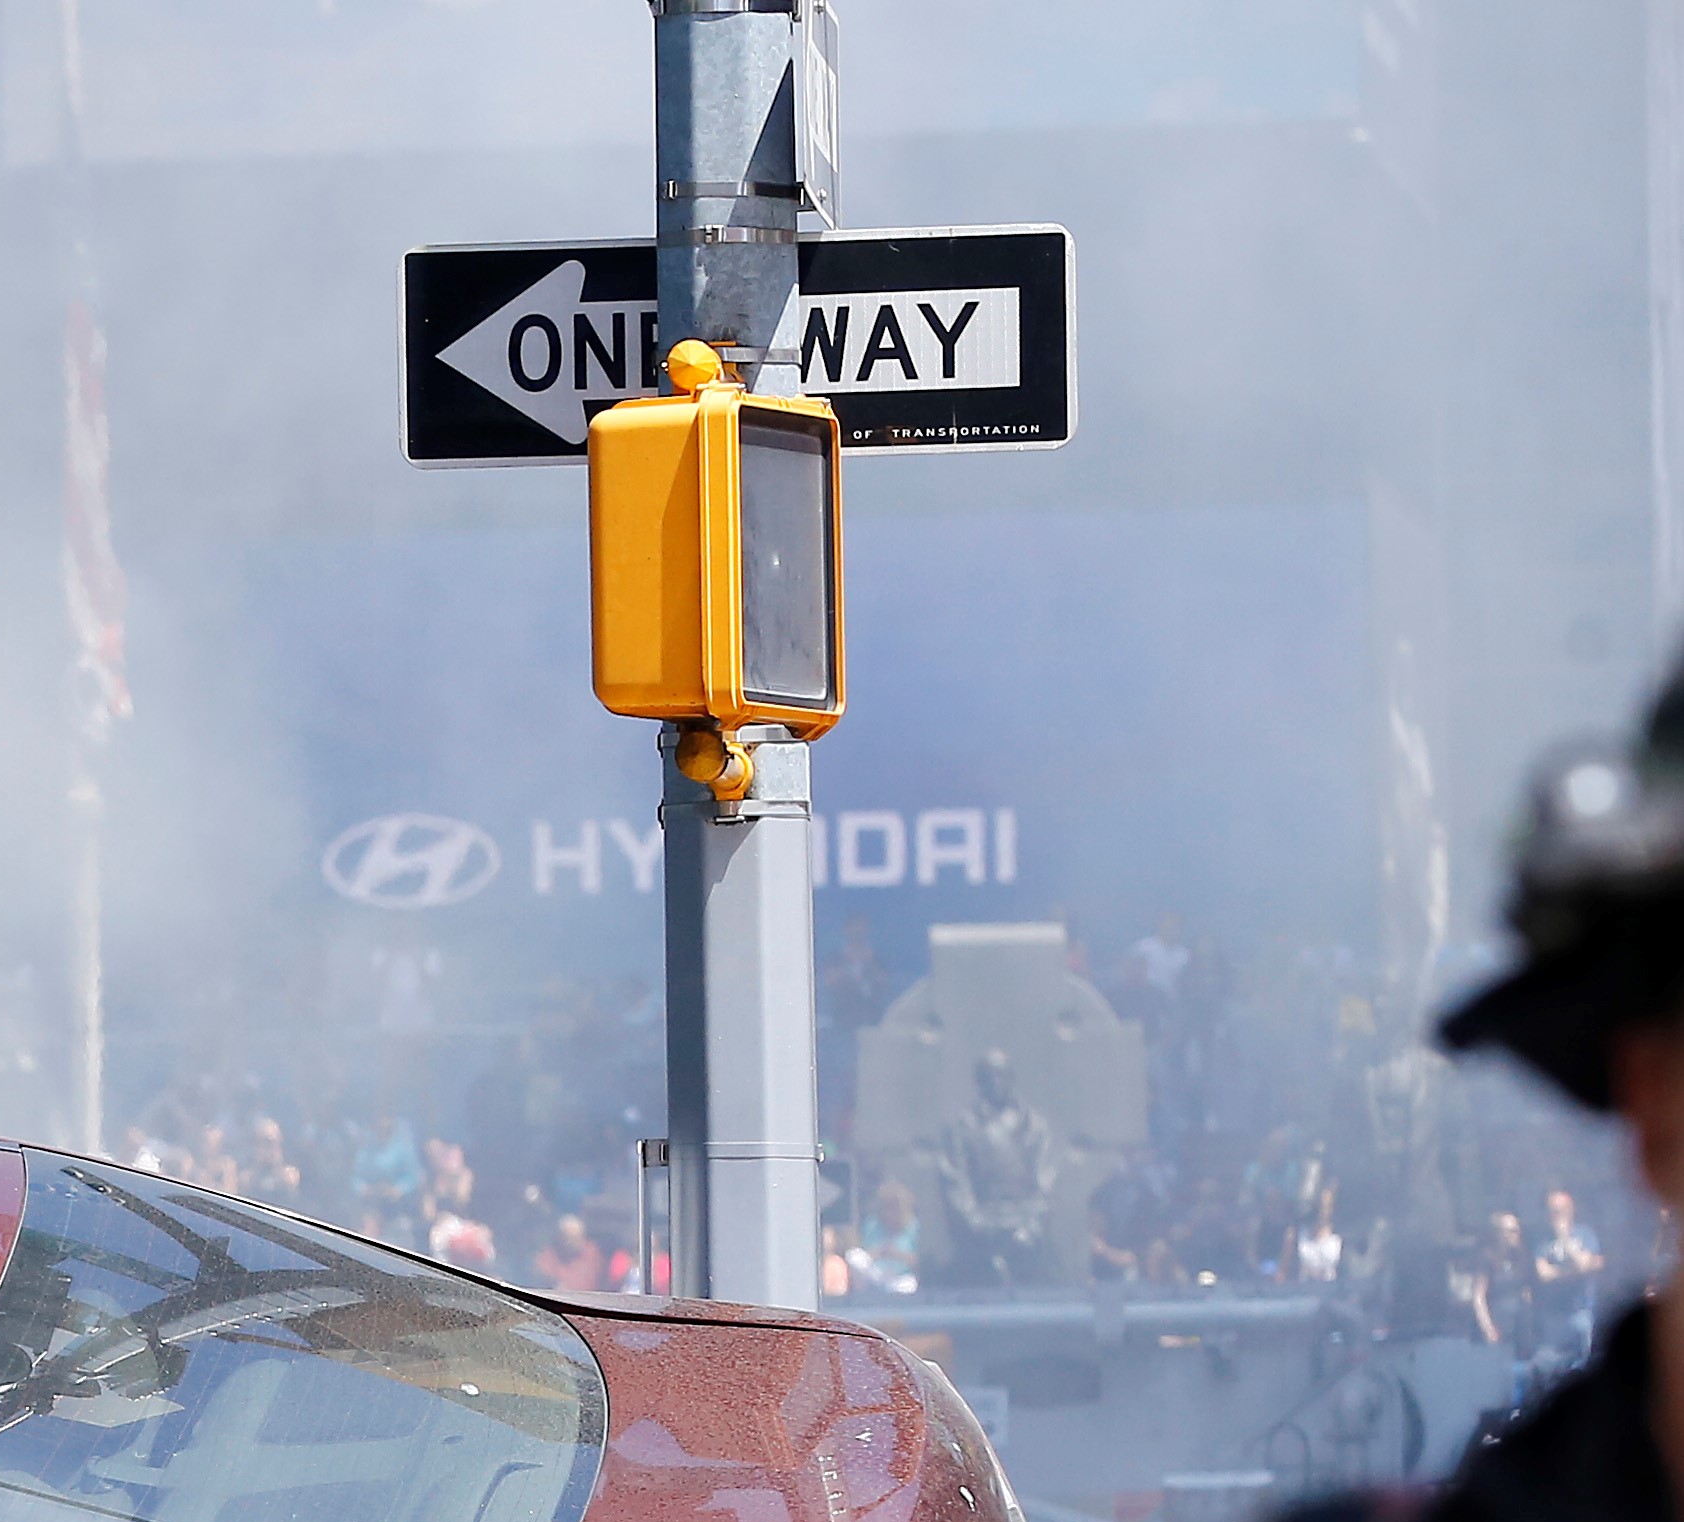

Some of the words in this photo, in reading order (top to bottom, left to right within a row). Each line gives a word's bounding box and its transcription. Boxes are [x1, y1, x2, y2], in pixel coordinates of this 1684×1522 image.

[852, 429, 873, 440] OF
[892, 424, 1040, 438] TRANSPORTATION
[536, 807, 1017, 893] HYDAI
